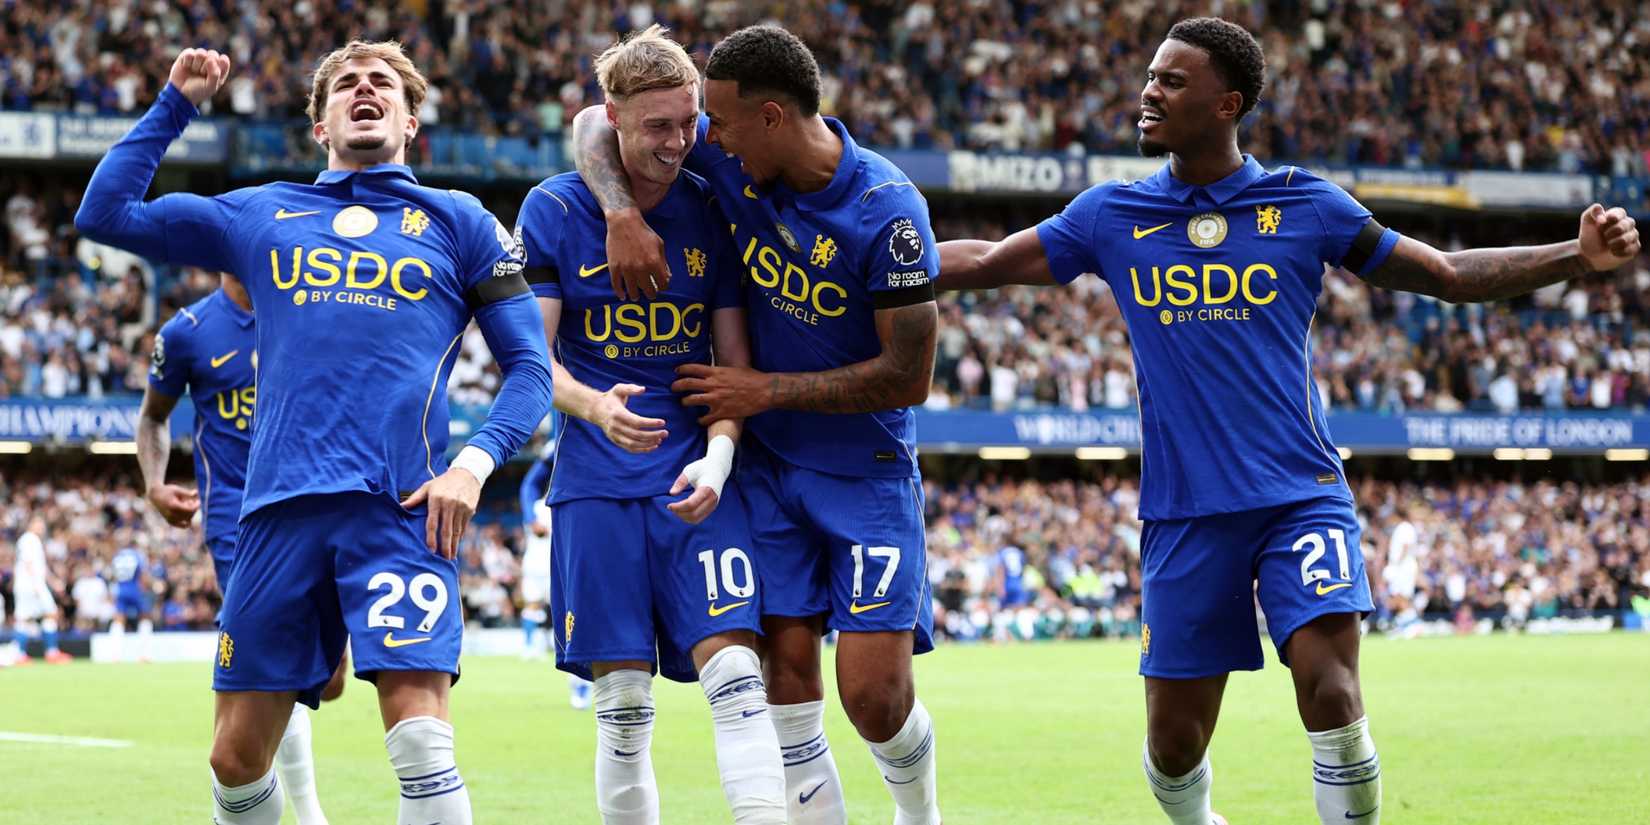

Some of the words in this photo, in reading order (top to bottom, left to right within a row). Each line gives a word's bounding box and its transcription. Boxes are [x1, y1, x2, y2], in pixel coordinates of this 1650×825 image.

[271, 247, 432, 301] USDC
[888, 272, 901, 280] No
[903, 271, 926, 280] room
[902, 277, 930, 287] racism
[1130, 263, 1278, 307] USDC
[311, 291, 332, 302] BY
[335, 291, 397, 311] CIRCLE
[771, 296, 820, 326] CIRCLE
[1177, 310, 1194, 322] BY
[1197, 308, 1251, 321] CIRCLE
[584, 302, 705, 343] USDC
[623, 347, 641, 358] BY
[644, 342, 691, 357] CIRCLE
[217, 386, 256, 419] US
[0, 404, 139, 437] HAMPION
[1406, 416, 1446, 445] THE
[1451, 417, 1512, 445] PRIDE
[1514, 417, 1543, 446] OF
[1547, 417, 1633, 446] LONDON
[699, 547, 756, 601] 10
[851, 545, 901, 597] 17
[1292, 529, 1351, 586] 21
[368, 572, 448, 632] 29
